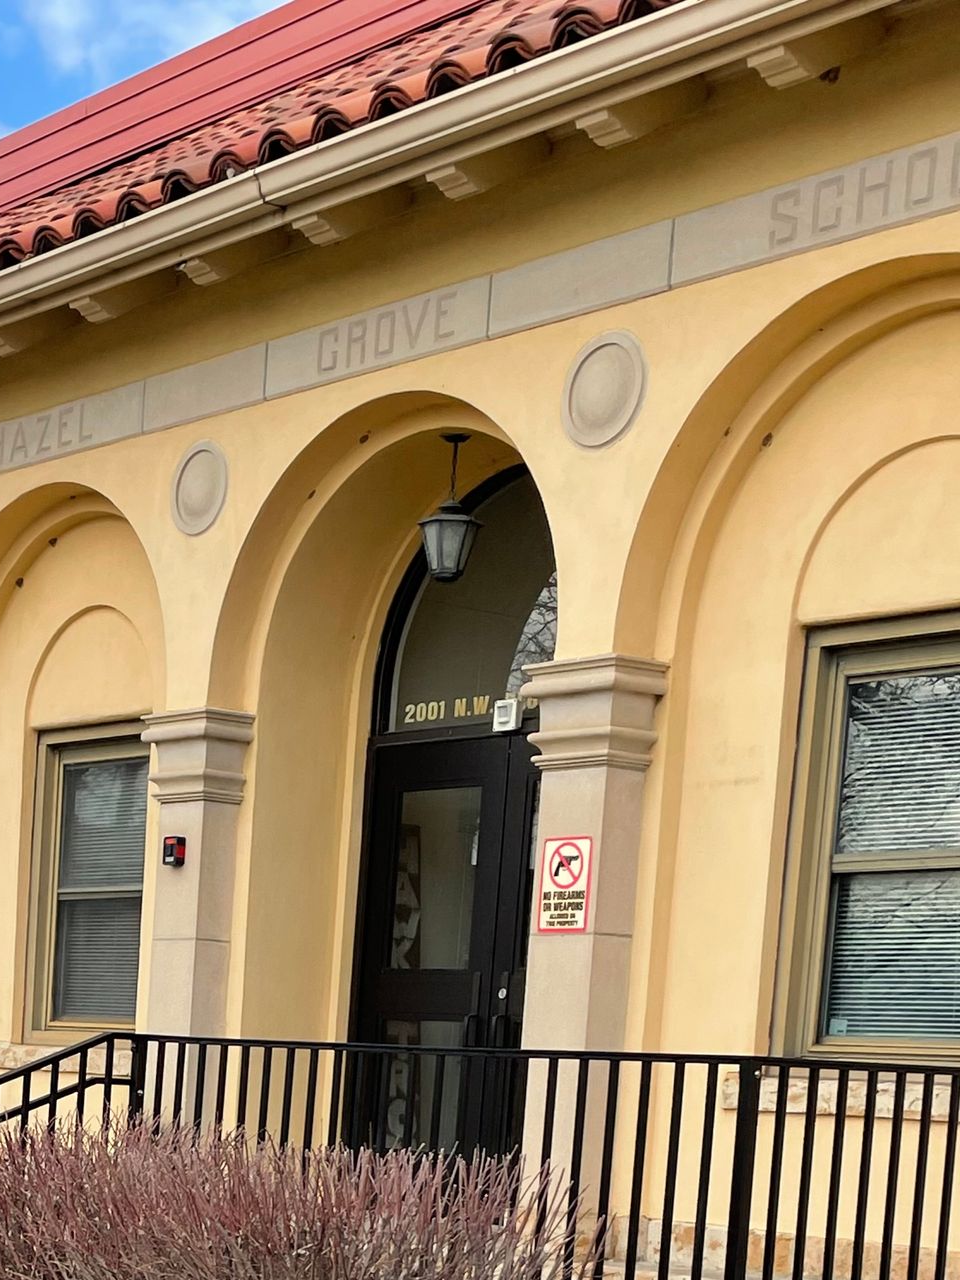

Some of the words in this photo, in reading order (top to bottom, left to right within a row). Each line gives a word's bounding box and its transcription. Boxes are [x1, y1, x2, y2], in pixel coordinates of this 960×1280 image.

[316, 290, 458, 374] GROVE
[404, 700, 446, 723] 2001
[453, 695, 494, 718] N.W.
[543, 891, 551, 900] NO
[553, 891, 585, 900] FIREARMS
[543, 902, 551, 911] OR
[553, 902, 584, 911] WEAPONS
